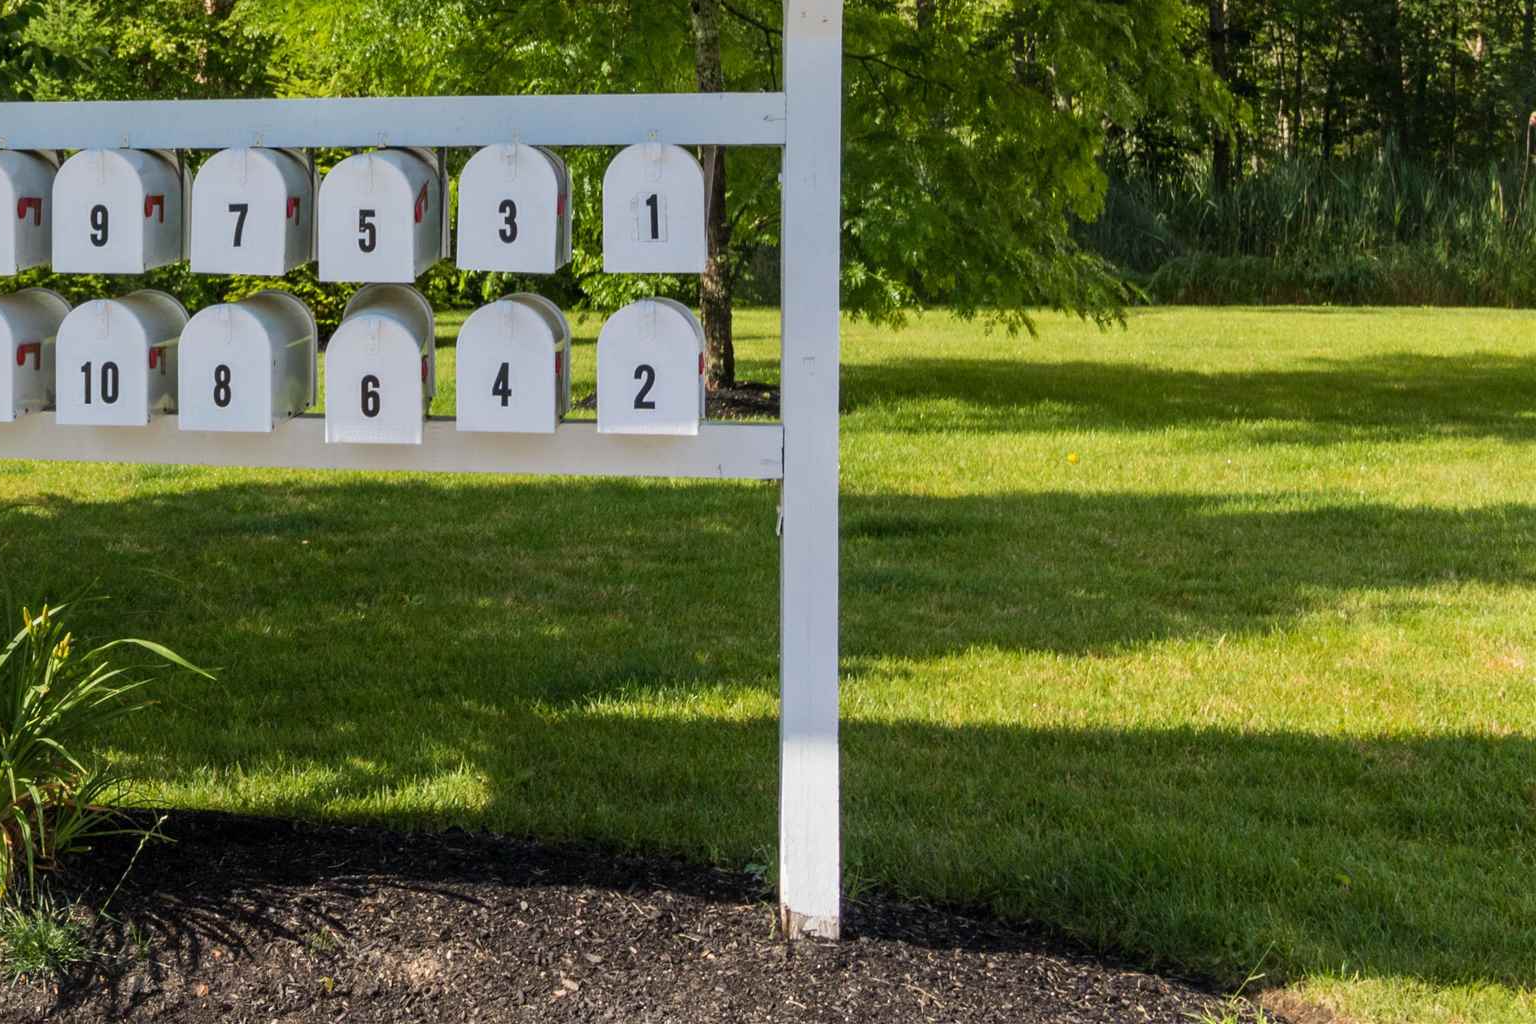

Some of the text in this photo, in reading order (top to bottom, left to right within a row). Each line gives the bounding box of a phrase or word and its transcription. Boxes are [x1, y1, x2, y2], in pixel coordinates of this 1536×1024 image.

[89, 204, 109, 248] 9
[228, 203, 249, 248] 7
[358, 209, 377, 254] 5
[498, 198, 518, 244] 3
[645, 193, 660, 240] 1
[80, 361, 120, 405] 10
[213, 364, 232, 408] 8
[360, 374, 381, 418] 6
[491, 362, 513, 407] 4
[633, 363, 656, 410] 2
